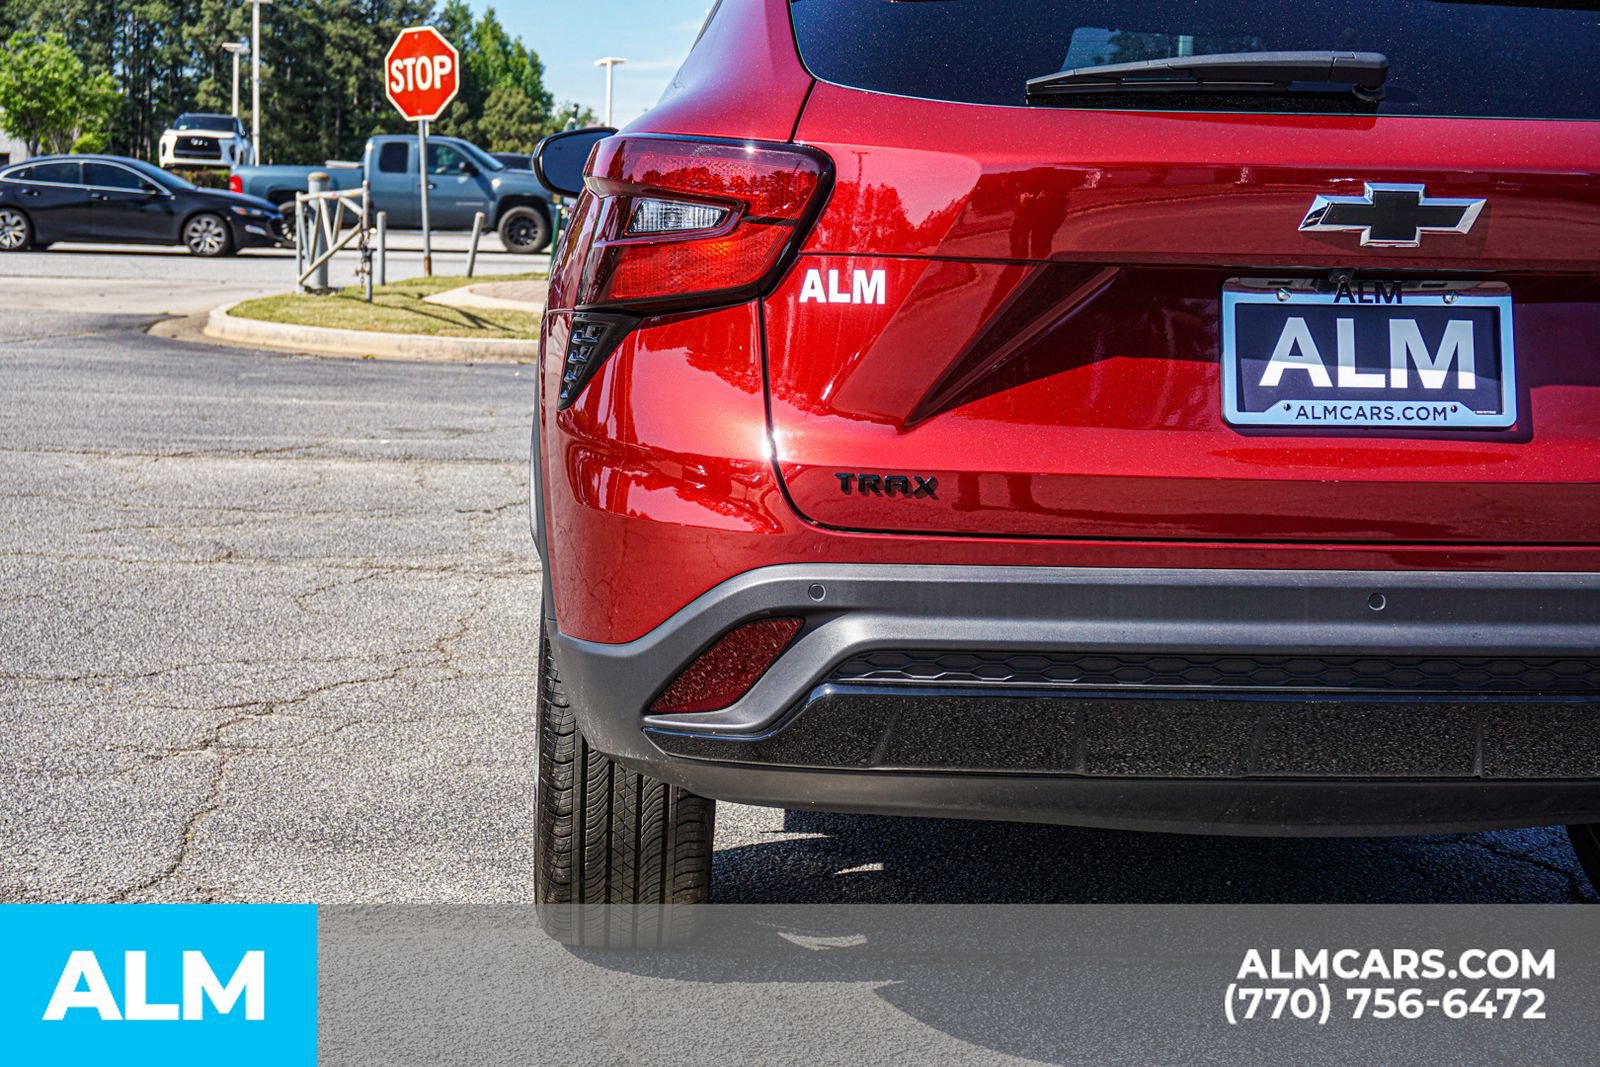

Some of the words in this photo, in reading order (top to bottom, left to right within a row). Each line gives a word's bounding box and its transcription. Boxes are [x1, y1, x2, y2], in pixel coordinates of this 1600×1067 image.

[391, 55, 452, 93] STOP
[799, 268, 886, 304] ALM
[1333, 282, 1403, 304] ALM
[1258, 316, 1476, 390] ALM
[1295, 405, 1448, 421] ALMCARS.COM
[834, 473, 938, 499] TRAX
